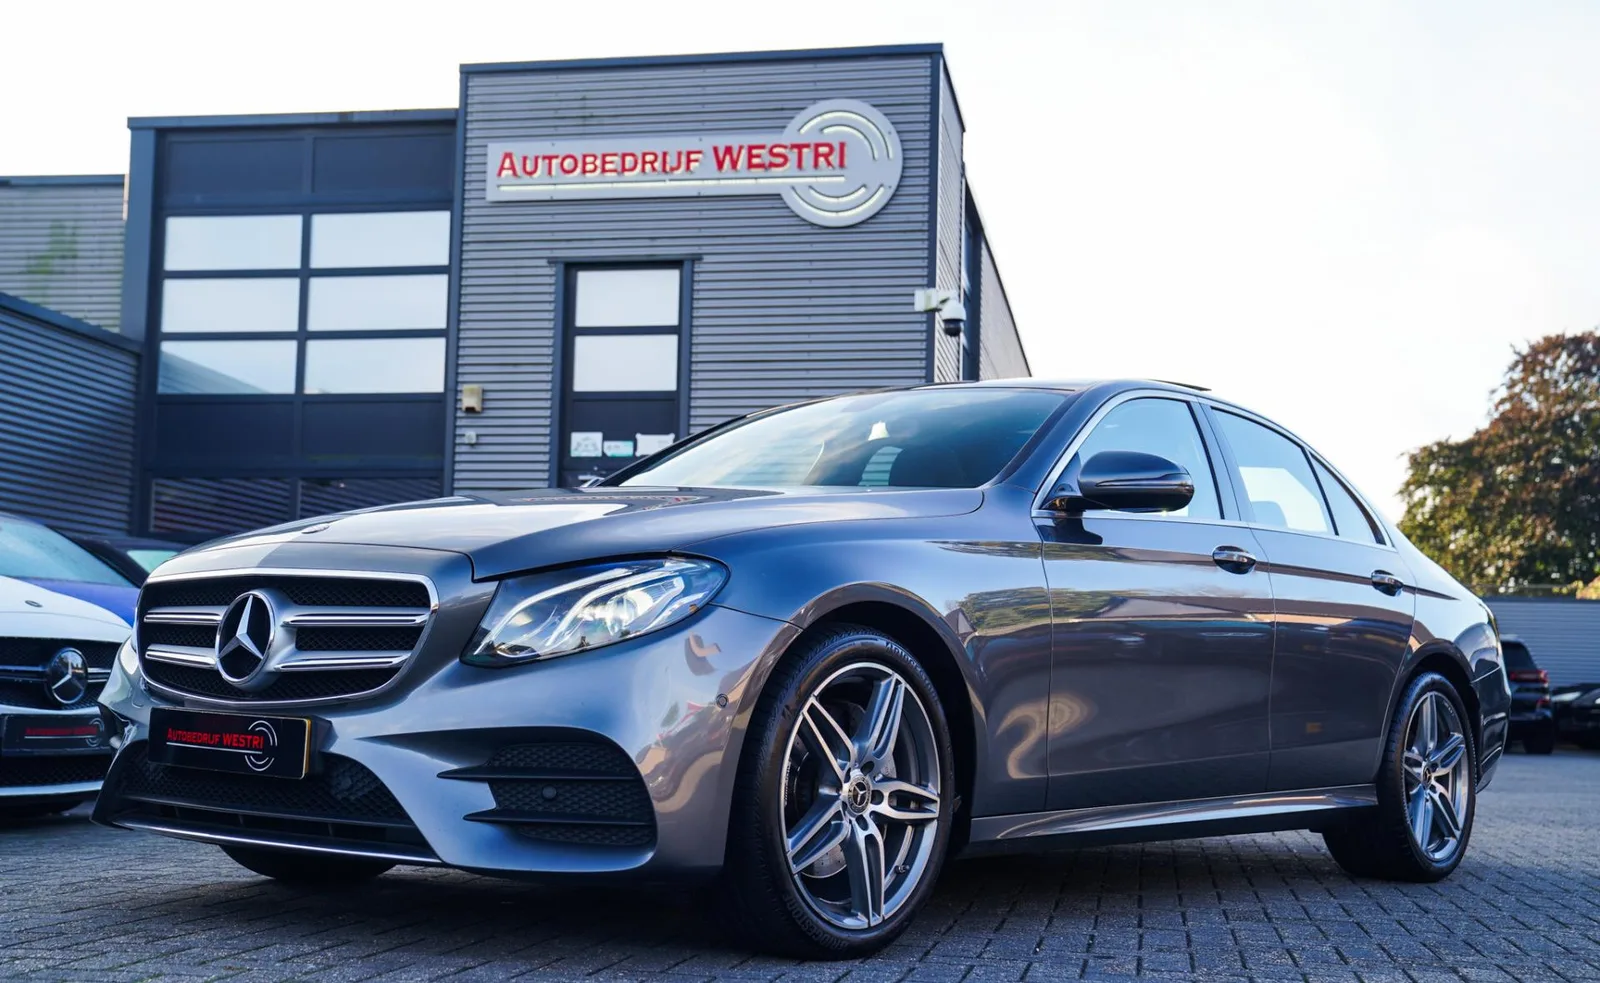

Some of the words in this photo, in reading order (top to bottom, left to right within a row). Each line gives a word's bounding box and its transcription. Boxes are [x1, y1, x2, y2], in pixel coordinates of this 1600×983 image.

[496, 150, 704, 178] AUTOBEDRIJF
[712, 141, 848, 173] WESTRI
[166, 727, 221, 745] AUTOBEDRIJF
[222, 732, 265, 750] WESTRI
